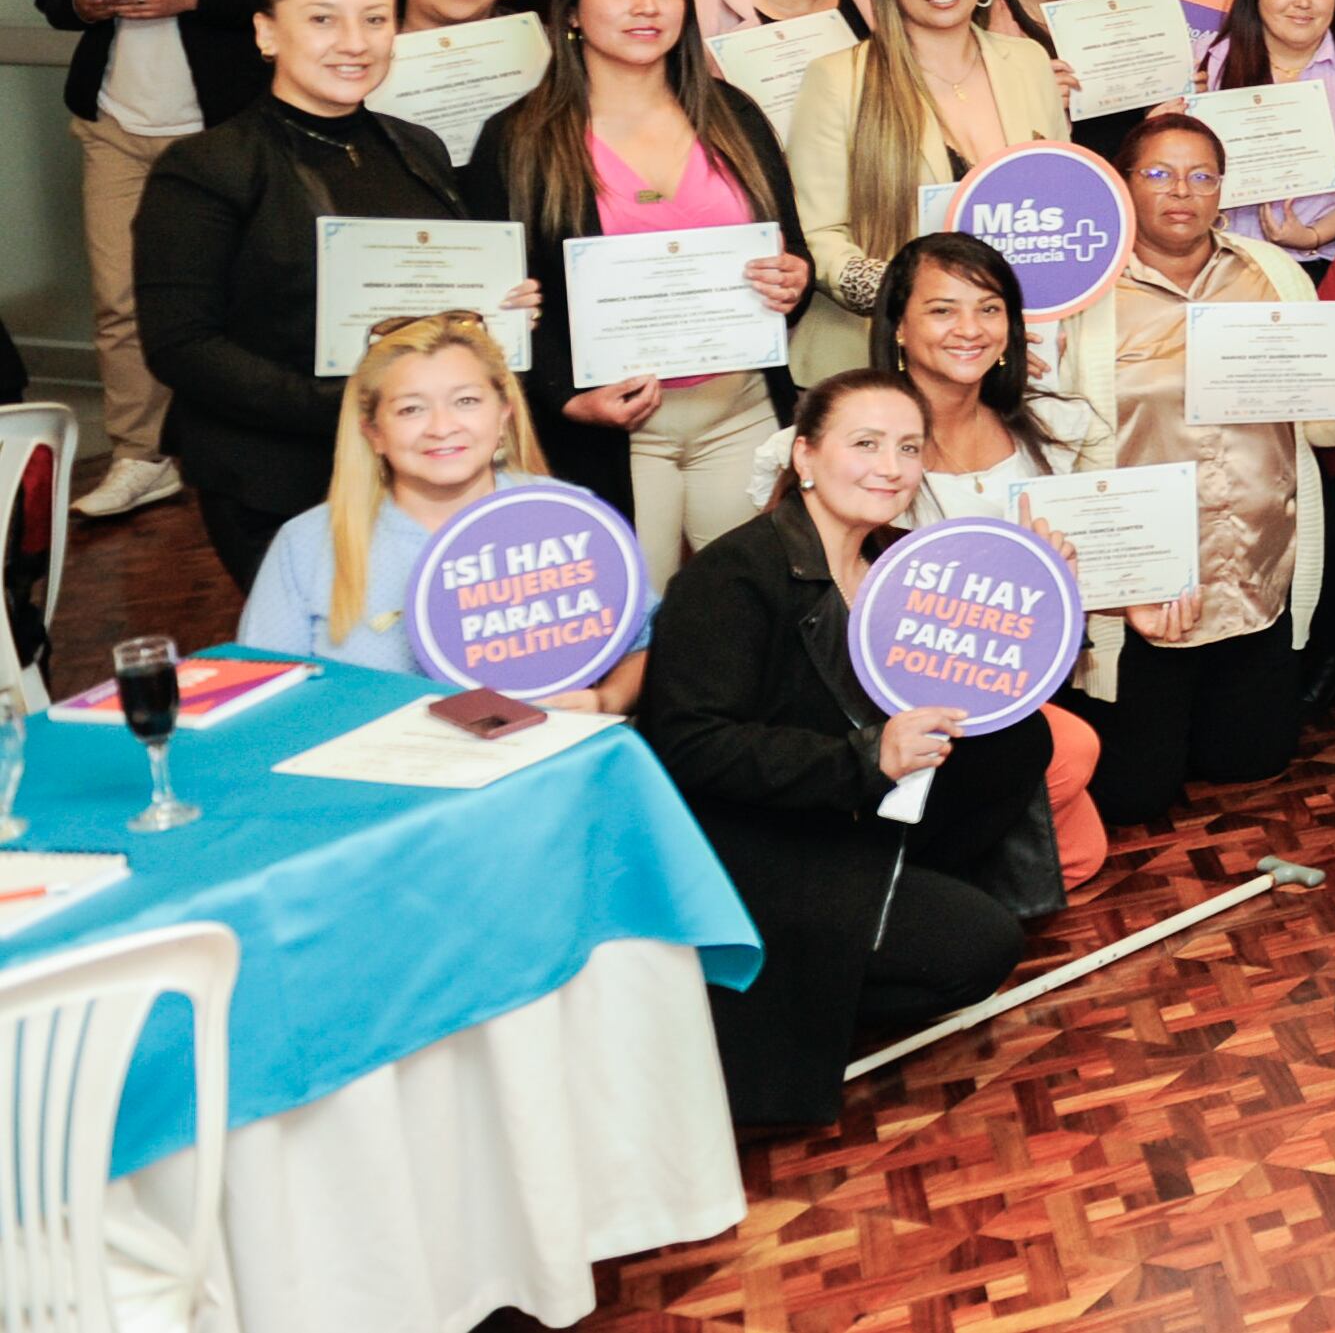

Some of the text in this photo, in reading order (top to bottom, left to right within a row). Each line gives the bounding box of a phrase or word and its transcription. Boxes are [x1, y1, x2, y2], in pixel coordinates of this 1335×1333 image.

[973, 199, 1064, 234] Más
[1005, 249, 1065, 265] ocracia
[442, 530, 592, 590] ¡SÍ HAY
[458, 559, 596, 610] MUJERES
[902, 560, 1045, 615] ¡SÍ HAY
[461, 588, 602, 641] PARA LA
[465, 607, 614, 669] POLÍTICA!
[906, 588, 1035, 640] MUJERES
[895, 618, 1021, 670] PARA LA
[885, 645, 1029, 698] POLÍTICA!
